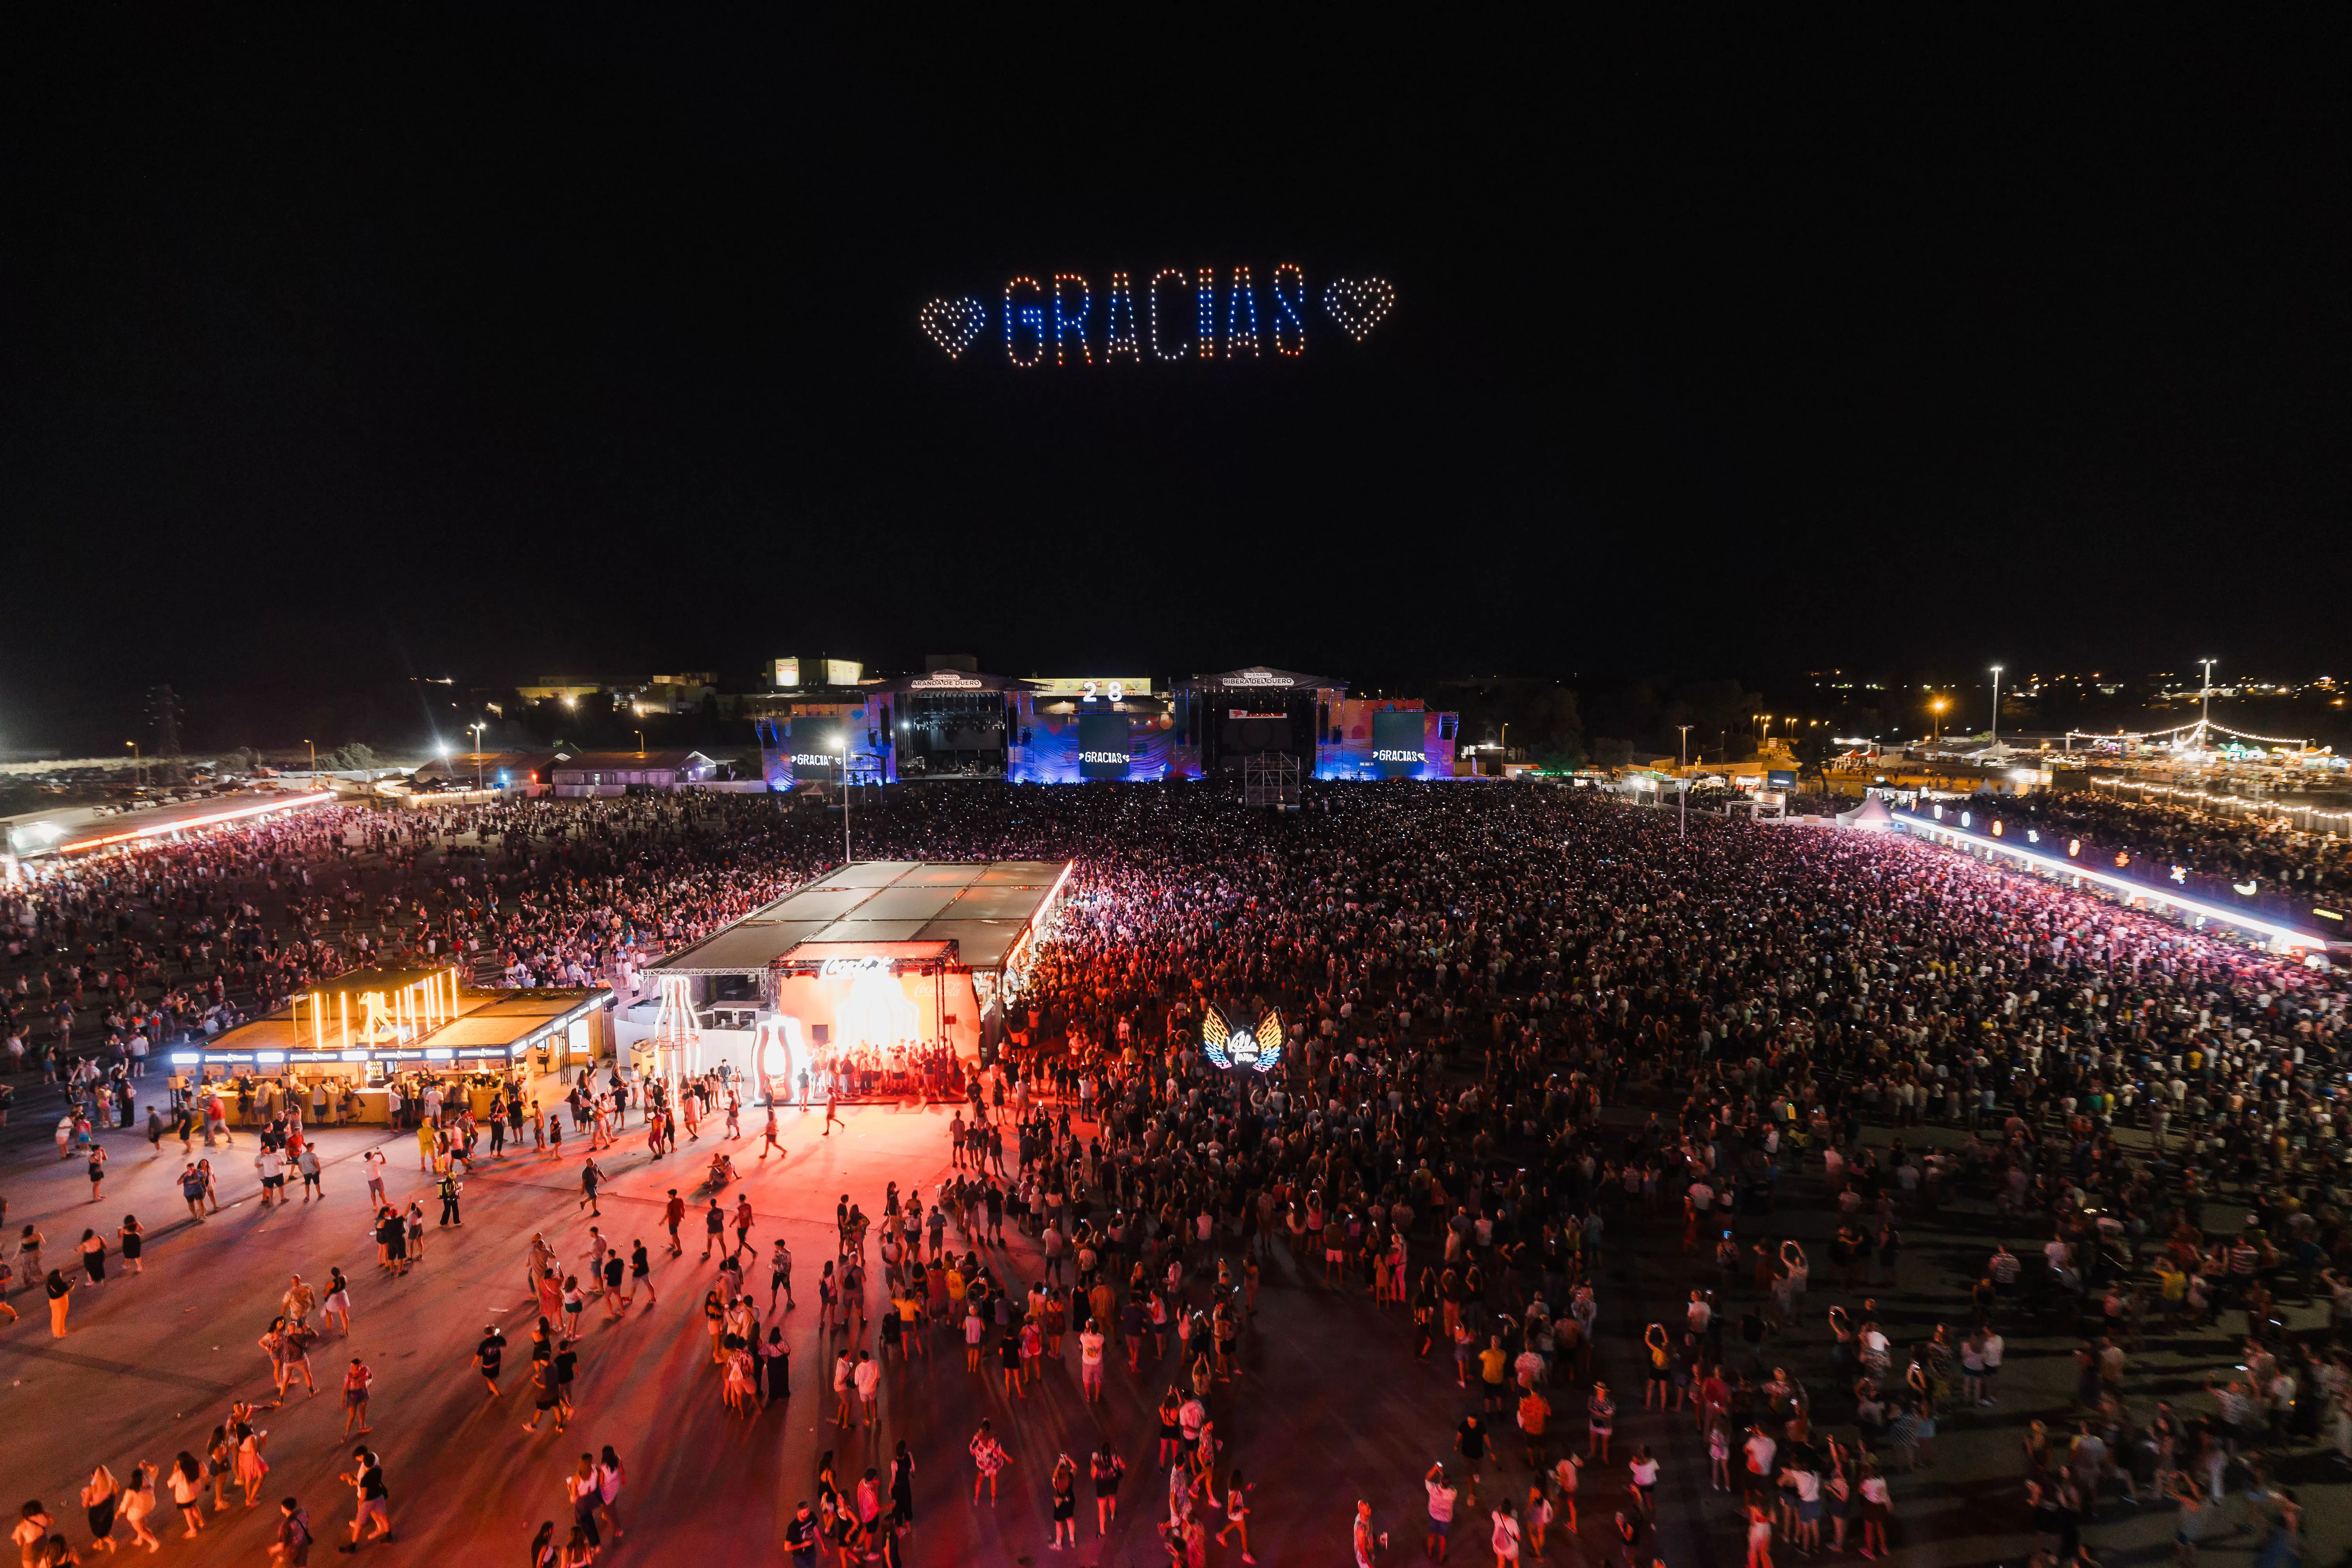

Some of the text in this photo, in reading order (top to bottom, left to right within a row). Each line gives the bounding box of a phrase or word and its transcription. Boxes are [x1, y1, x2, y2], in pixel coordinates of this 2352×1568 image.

[1005, 264, 1304, 367] GRACIAS
[1085, 751, 1122, 763] GRACIAS
[1379, 750, 1417, 762] GRACIAS
[820, 954, 895, 980] CocaCola
[914, 982, 963, 998] Cocaola
